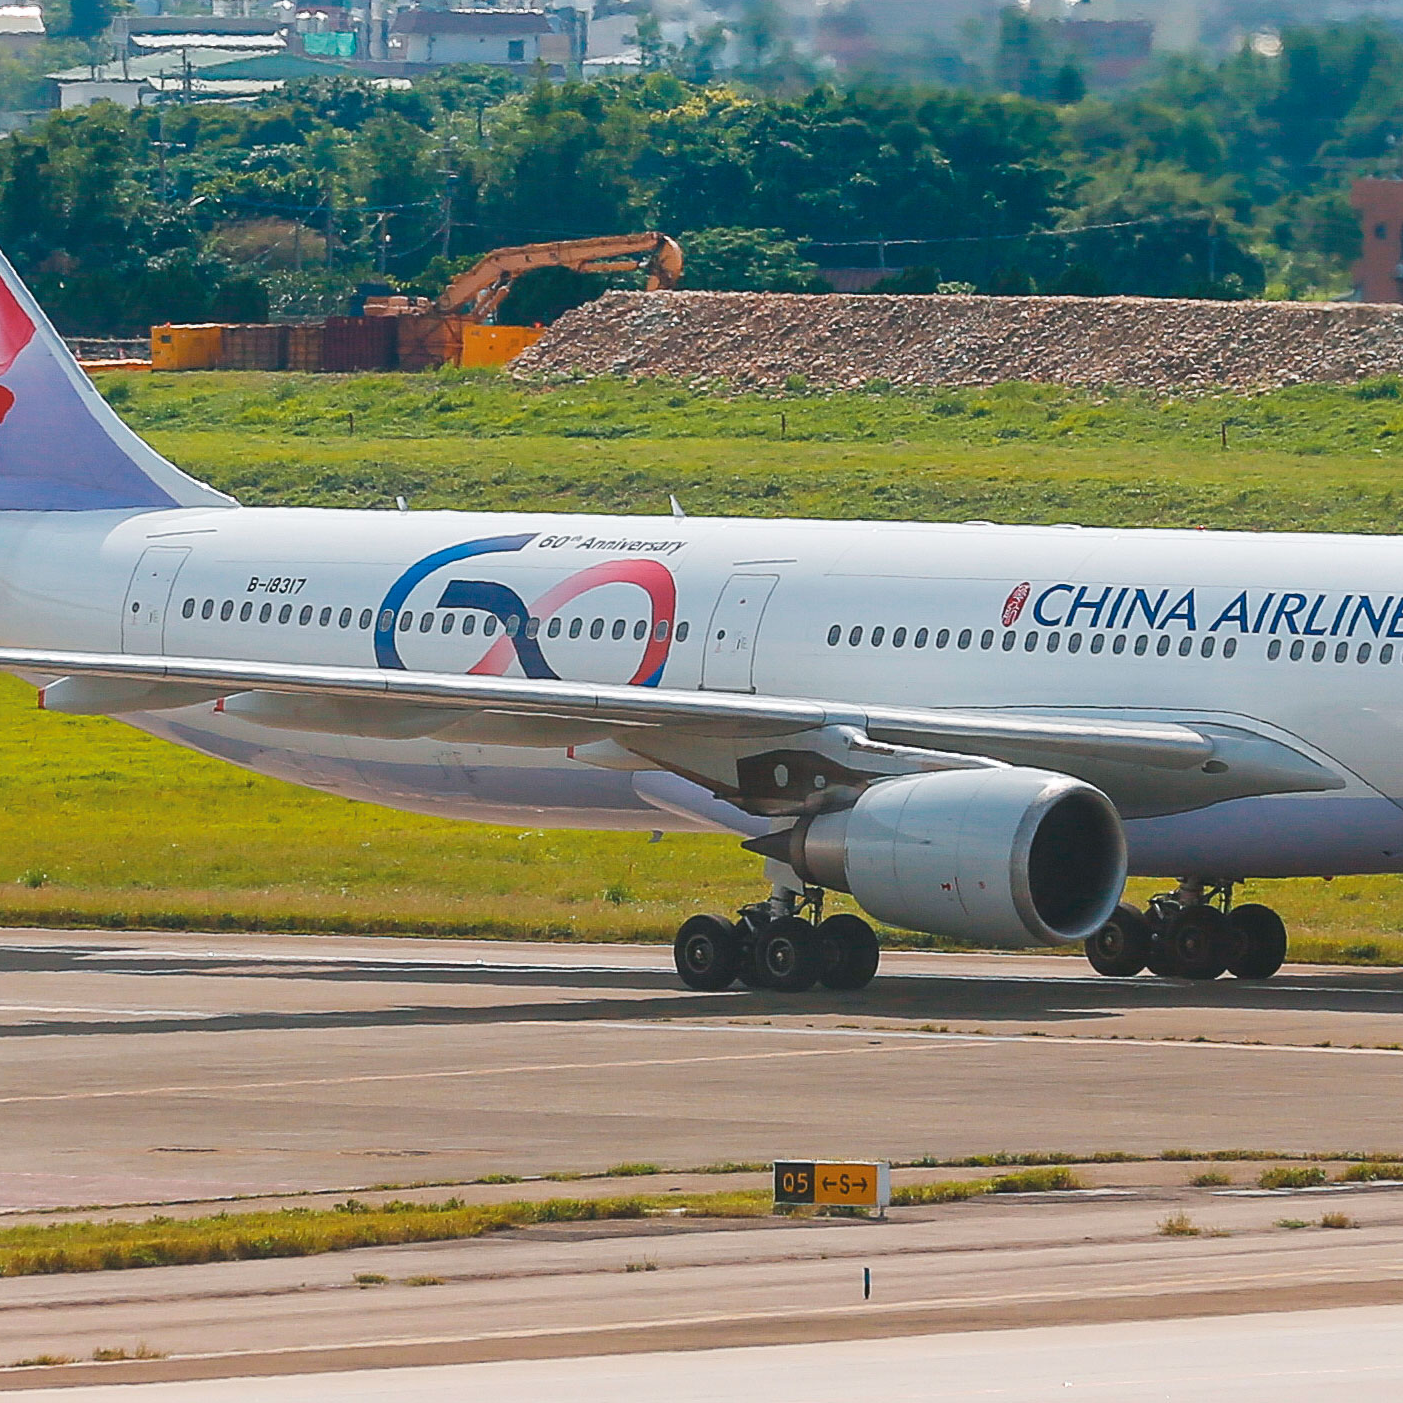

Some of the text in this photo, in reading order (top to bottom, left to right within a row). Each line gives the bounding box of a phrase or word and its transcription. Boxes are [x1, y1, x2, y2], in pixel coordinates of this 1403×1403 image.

[575, 537, 688, 556] Anniversary
[246, 576, 307, 595] B-18317
[1033, 583, 1197, 631] CHINA
[783, 1173, 850, 1195] Q5 S
